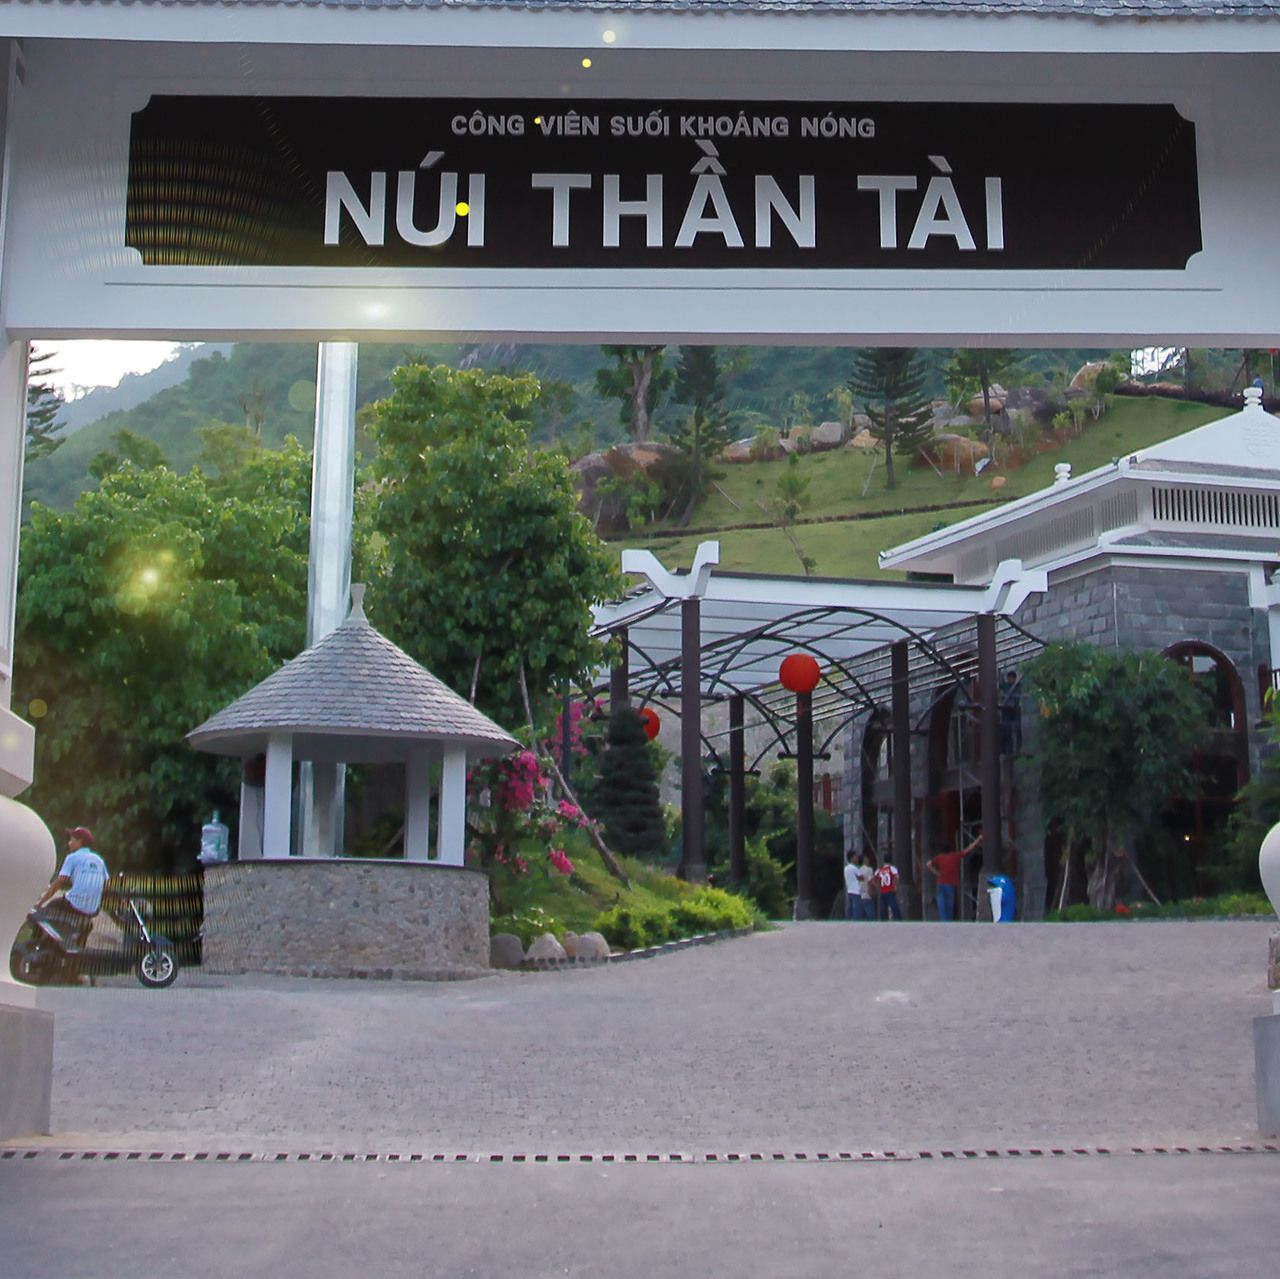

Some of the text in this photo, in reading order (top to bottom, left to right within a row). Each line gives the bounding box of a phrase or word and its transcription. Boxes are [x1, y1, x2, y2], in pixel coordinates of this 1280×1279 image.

[451, 109, 875, 137] CÔNG VIÊN SUỐI KHOÁNG NÓNG
[324, 139, 1004, 250] NÚI THẦN TÀI
